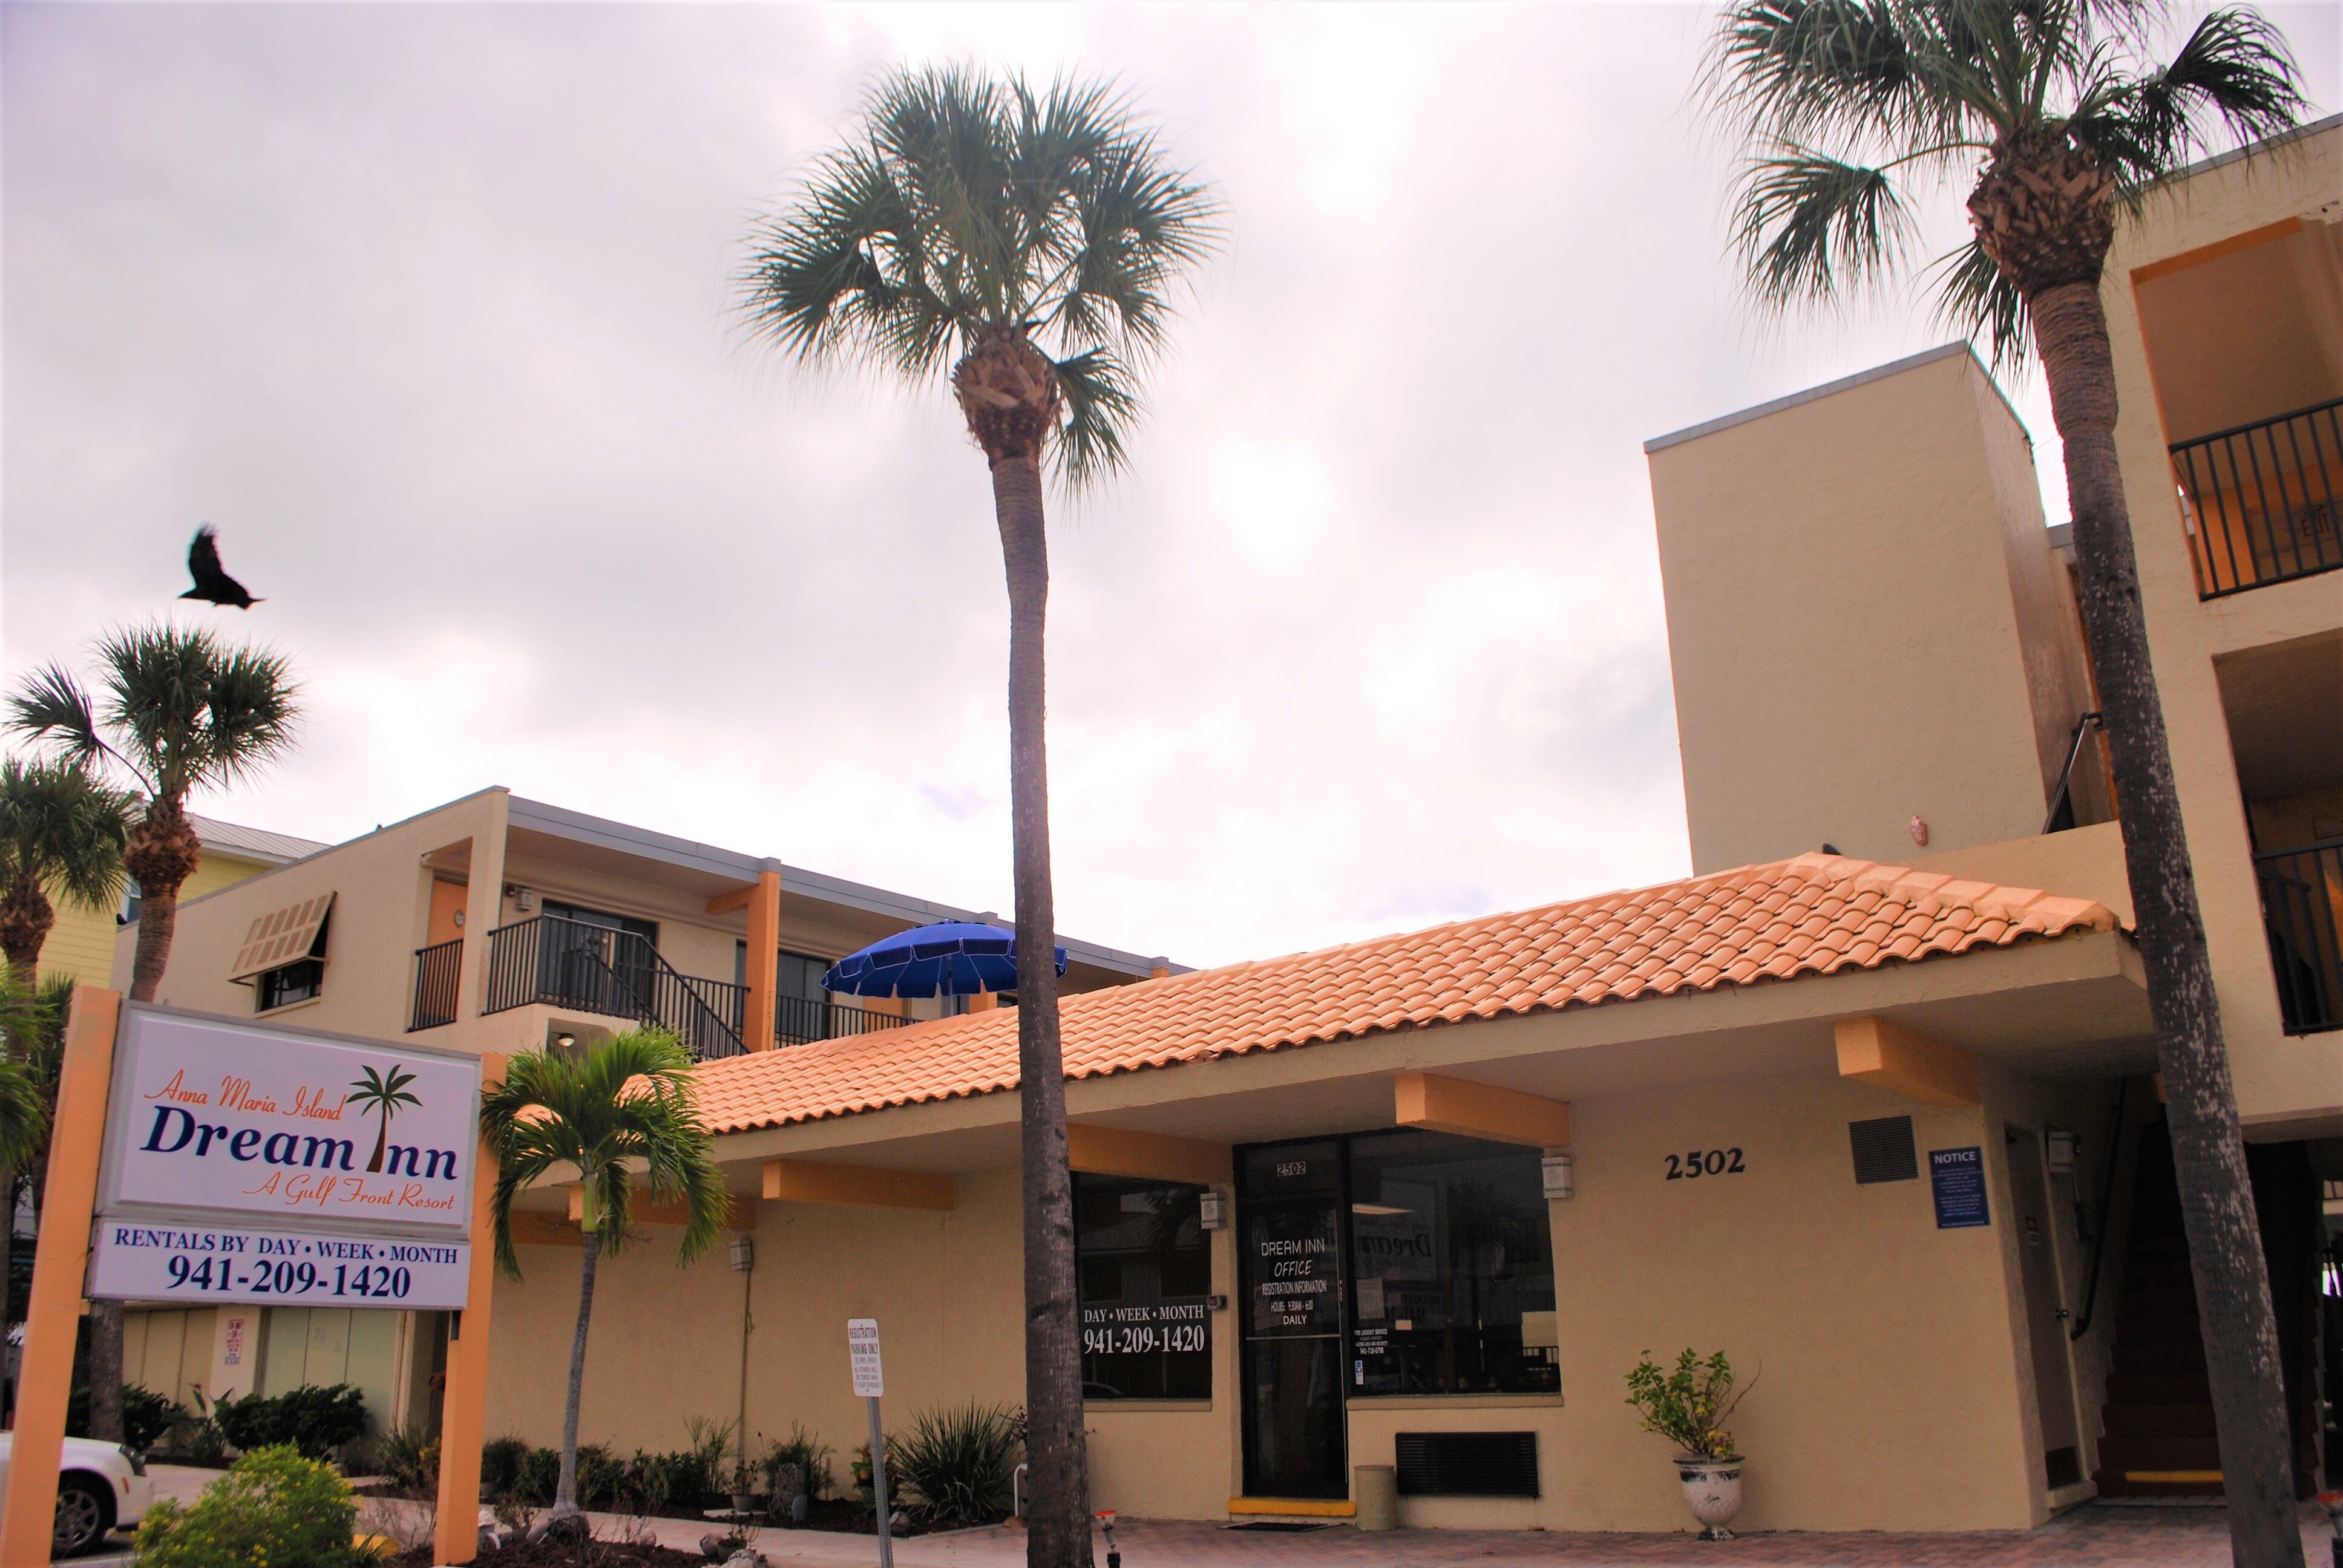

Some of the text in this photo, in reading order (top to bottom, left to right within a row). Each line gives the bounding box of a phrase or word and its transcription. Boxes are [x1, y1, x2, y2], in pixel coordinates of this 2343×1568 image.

[143, 1069, 347, 1120] Anna Maria Island
[140, 1105, 355, 1171] Dream
[1665, 1147, 1745, 1180] 2502
[1934, 1151, 1976, 1164] NOTICE
[1278, 1163, 1305, 1175] 2502
[243, 1171, 455, 1209] A Gulf Front Resort
[114, 1228, 458, 1264] RENTALS BY DAY WEEK MONTH
[1261, 1238, 1325, 1256] DREAM INN
[167, 1255, 411, 1298] 941-209-1420
[1274, 1259, 1312, 1277] OFFICE
[1262, 1279, 1327, 1295] REGISTRATION INFORMATION
[1084, 1305, 1204, 1322] DAY WEEK MONTH
[1283, 1315, 1308, 1325] DAILY
[851, 1343, 879, 1354] PARKING ONLY
[1084, 1325, 1205, 1354] 941-209-1420
